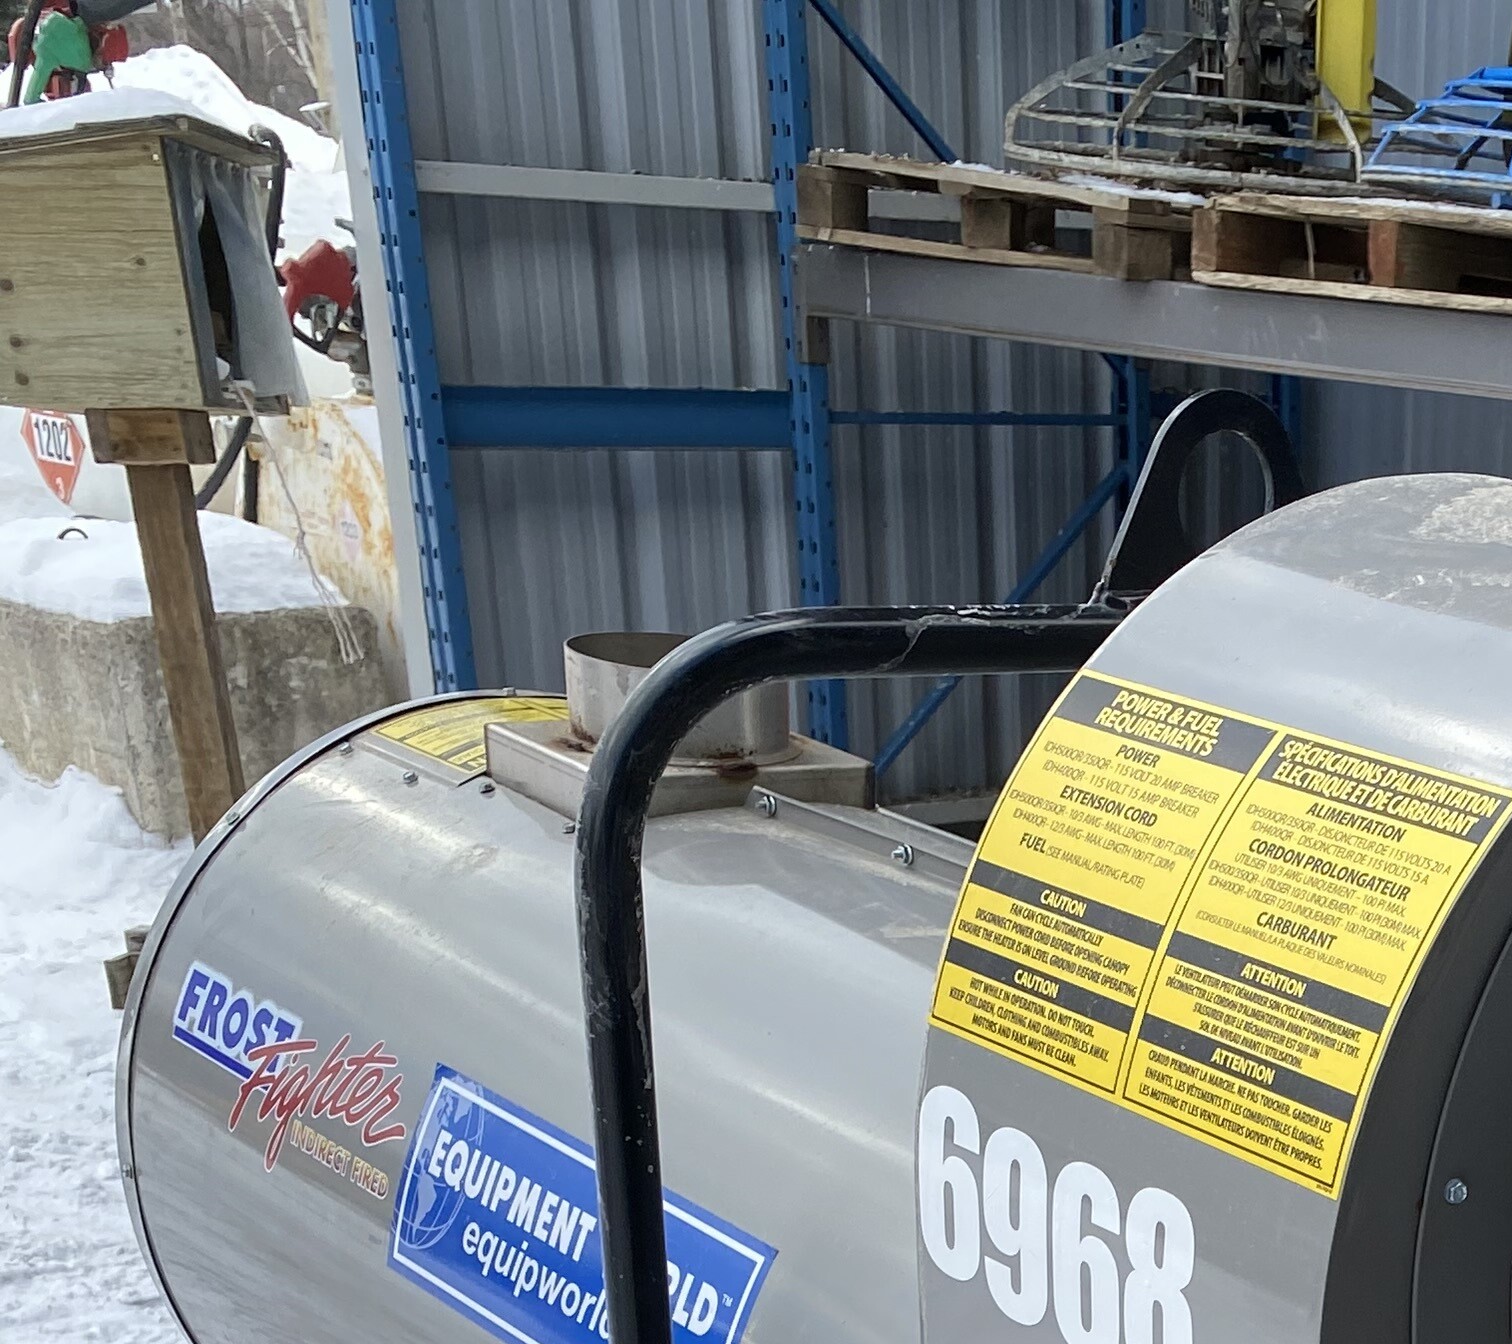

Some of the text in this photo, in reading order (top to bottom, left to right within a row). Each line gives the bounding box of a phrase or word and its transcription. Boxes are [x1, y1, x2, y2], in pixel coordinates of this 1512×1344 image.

[33, 417, 72, 462] 1202
[1093, 706, 1218, 757] REQUIREMENTS
[1110, 689, 1226, 737] POWER & FUEL
[1115, 743, 1161, 768] POWER
[1277, 739, 1502, 817] SPÉCIFICATIONS D'ALIMENTATION
[1059, 784, 1159, 827] EXTENSION CORD
[1270, 758, 1479, 837] ÉLECTRIQUE ET DE CARBURANT
[1305, 801, 1407, 842] ALIMENTATION
[1018, 831, 1146, 888] FUEL (SEE MANUAL/RATING PLATE)
[1247, 837, 1411, 901] CORDON PROLONGATEUR
[1039, 887, 1087, 918] CAUTION
[1255, 910, 1337, 950] CARBURANT
[1013, 967, 1059, 999] CAUTION
[1239, 961, 1307, 998] ATTENTION
[177, 968, 296, 1073] FROST
[1210, 1046, 1276, 1085] ATTENTION
[228, 1033, 406, 1173] Fighter
[289, 1119, 390, 1200] INDIRECT FIRED
[427, 1128, 598, 1262] EQUIPMENT
